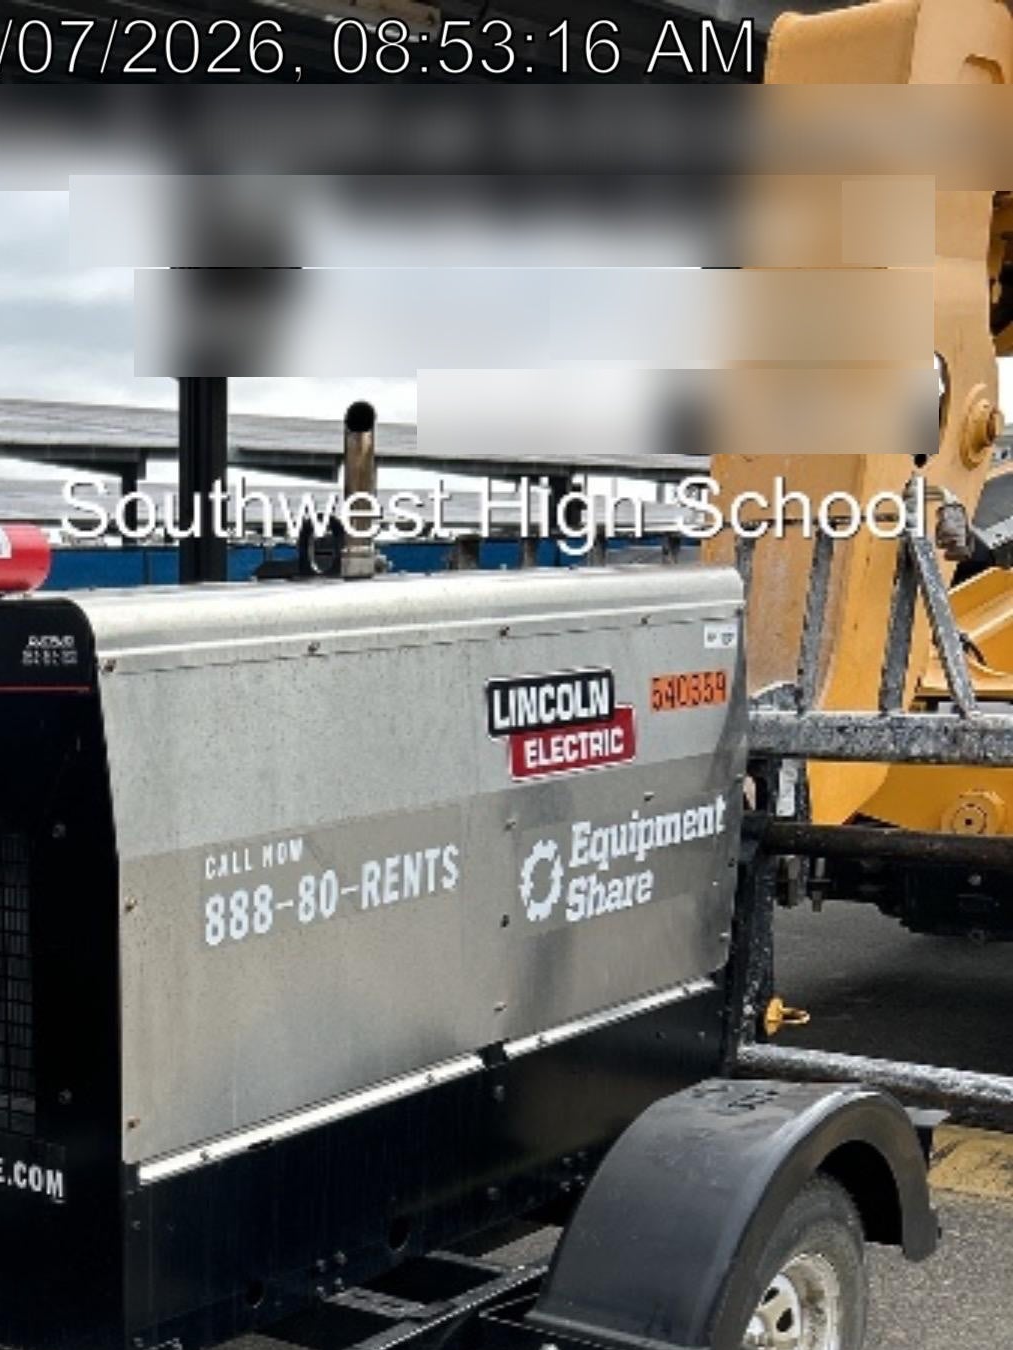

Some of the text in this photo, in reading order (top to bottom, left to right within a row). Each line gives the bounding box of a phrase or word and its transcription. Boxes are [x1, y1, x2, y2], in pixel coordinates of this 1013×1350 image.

[492, 676, 612, 730] LINCOLN
[523, 726, 625, 770] ELECTRIC
[204, 836, 304, 881] CALL NOW
[568, 794, 728, 871] Equipment
[204, 843, 461, 947] 888-80-RENTS
[565, 868, 655, 923] Share
